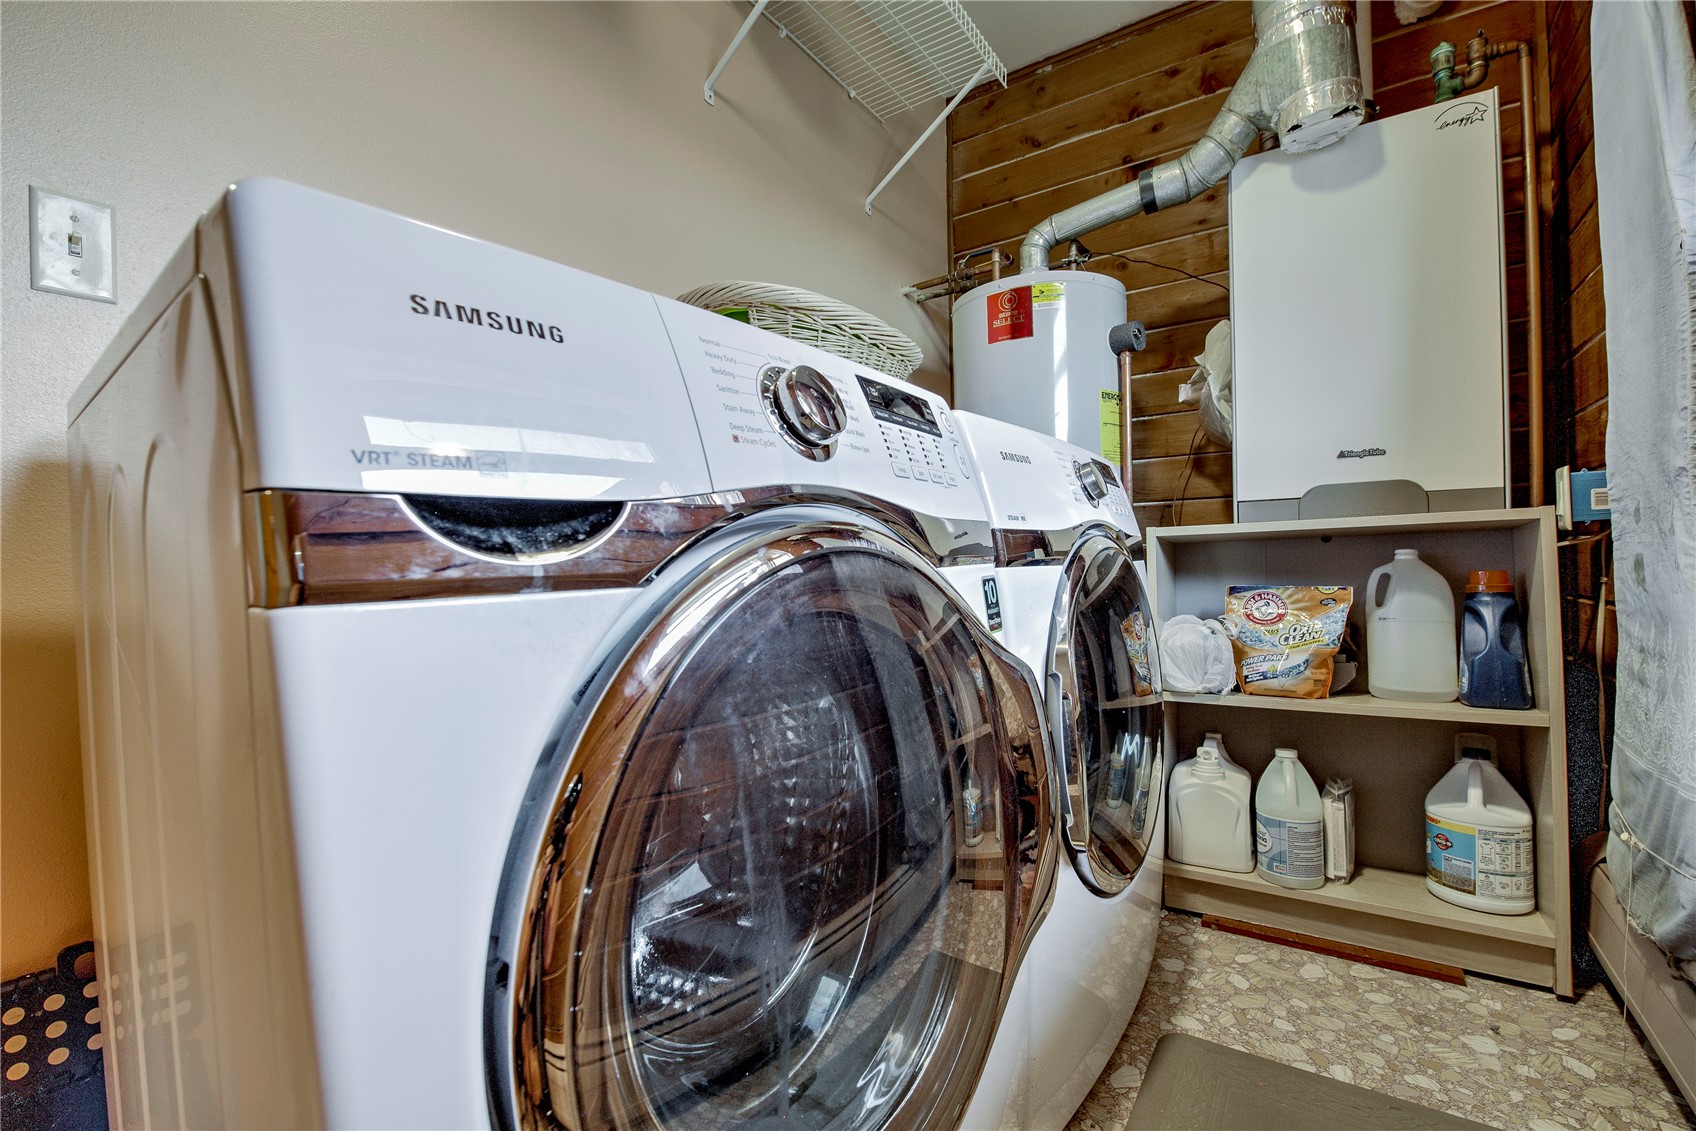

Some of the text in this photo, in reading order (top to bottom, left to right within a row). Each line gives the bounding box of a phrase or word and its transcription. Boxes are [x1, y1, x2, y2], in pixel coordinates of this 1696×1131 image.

[409, 294, 564, 344] SAMSUNG
[698, 335, 721, 346] Normal
[703, 350, 737, 365] Heavy Duty
[710, 366, 736, 379] Bedding
[716, 384, 740, 395] Sanitize
[722, 403, 756, 416] Stain Away
[729, 422, 764, 434] Deep Steam
[740, 436, 777, 448] Steam Cycles
[1000, 451, 1032, 465] SAMSUNG
[1344, 448, 1386, 459] Triangle Tube
[407, 453, 473, 470] STEAM
[984, 580, 998, 605] 10
[1240, 653, 1290, 667] POWER PAKS
